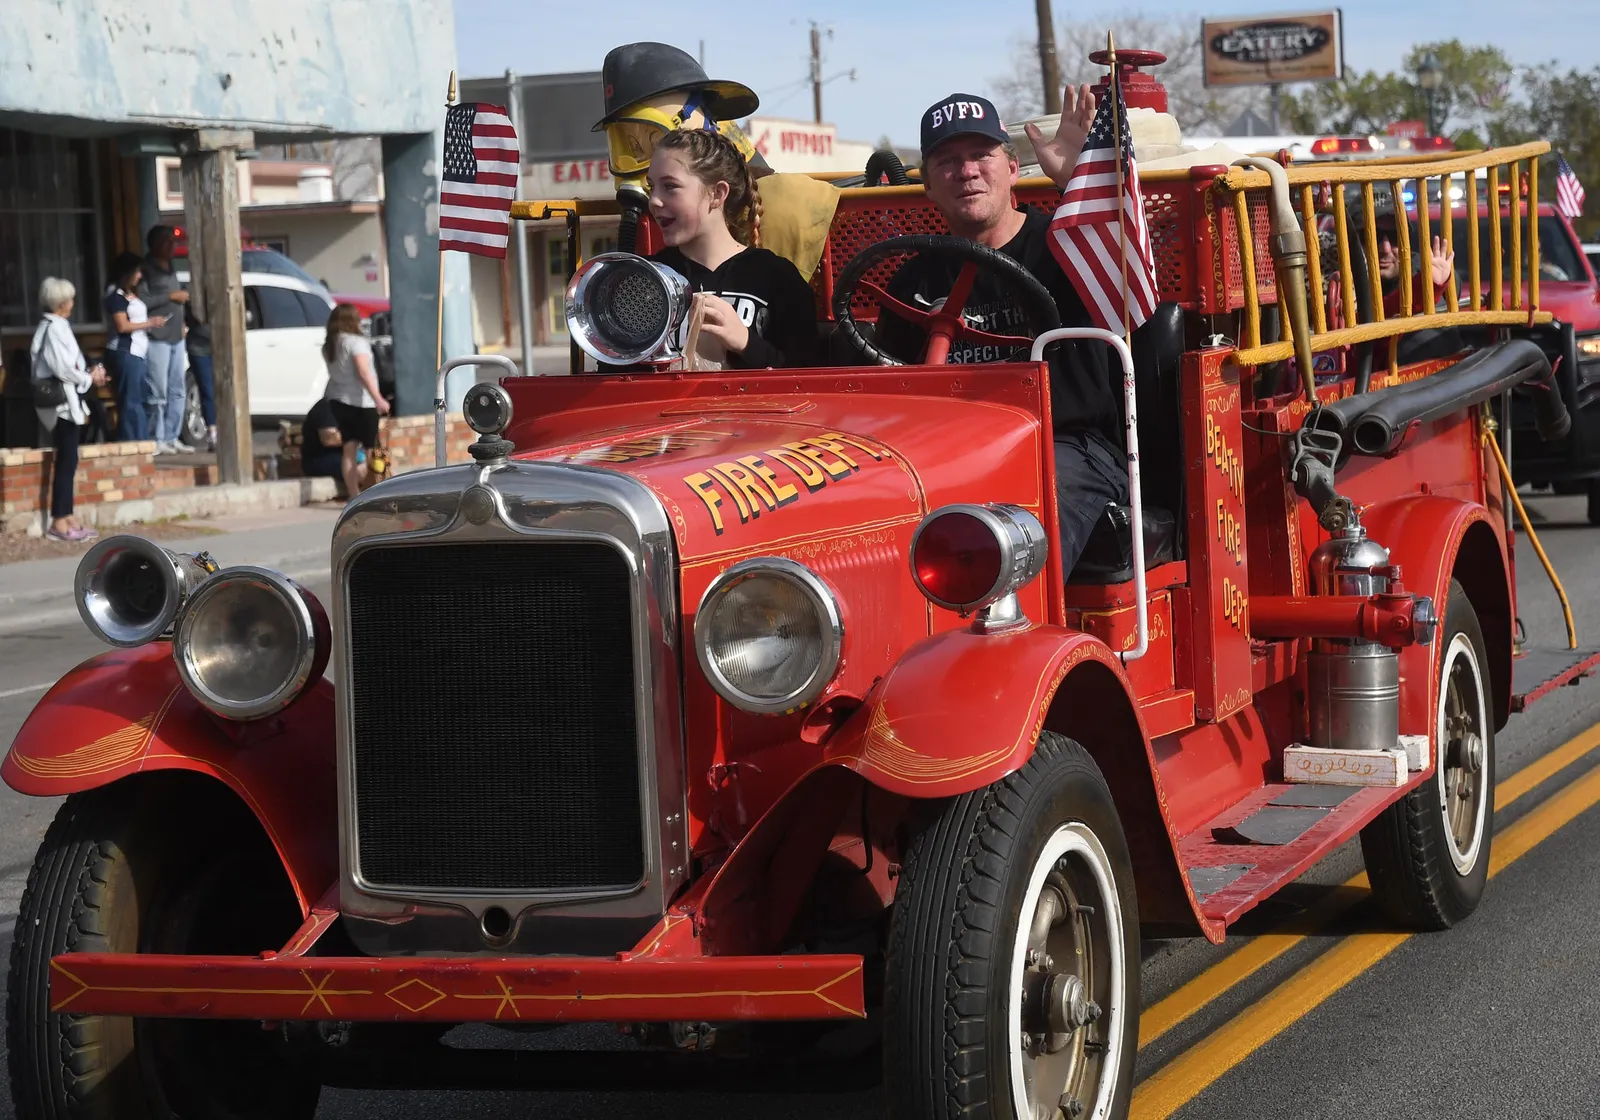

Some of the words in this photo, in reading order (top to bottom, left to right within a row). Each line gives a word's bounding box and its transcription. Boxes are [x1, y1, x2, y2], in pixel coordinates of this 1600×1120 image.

[1222, 32, 1318, 52] EATERY
[931, 101, 985, 128] BVFD
[683, 455, 798, 536] FIRE
[765, 433, 891, 494] DEPT.
[1206, 413, 1244, 505] BEATTY
[1216, 498, 1242, 565] FIRE
